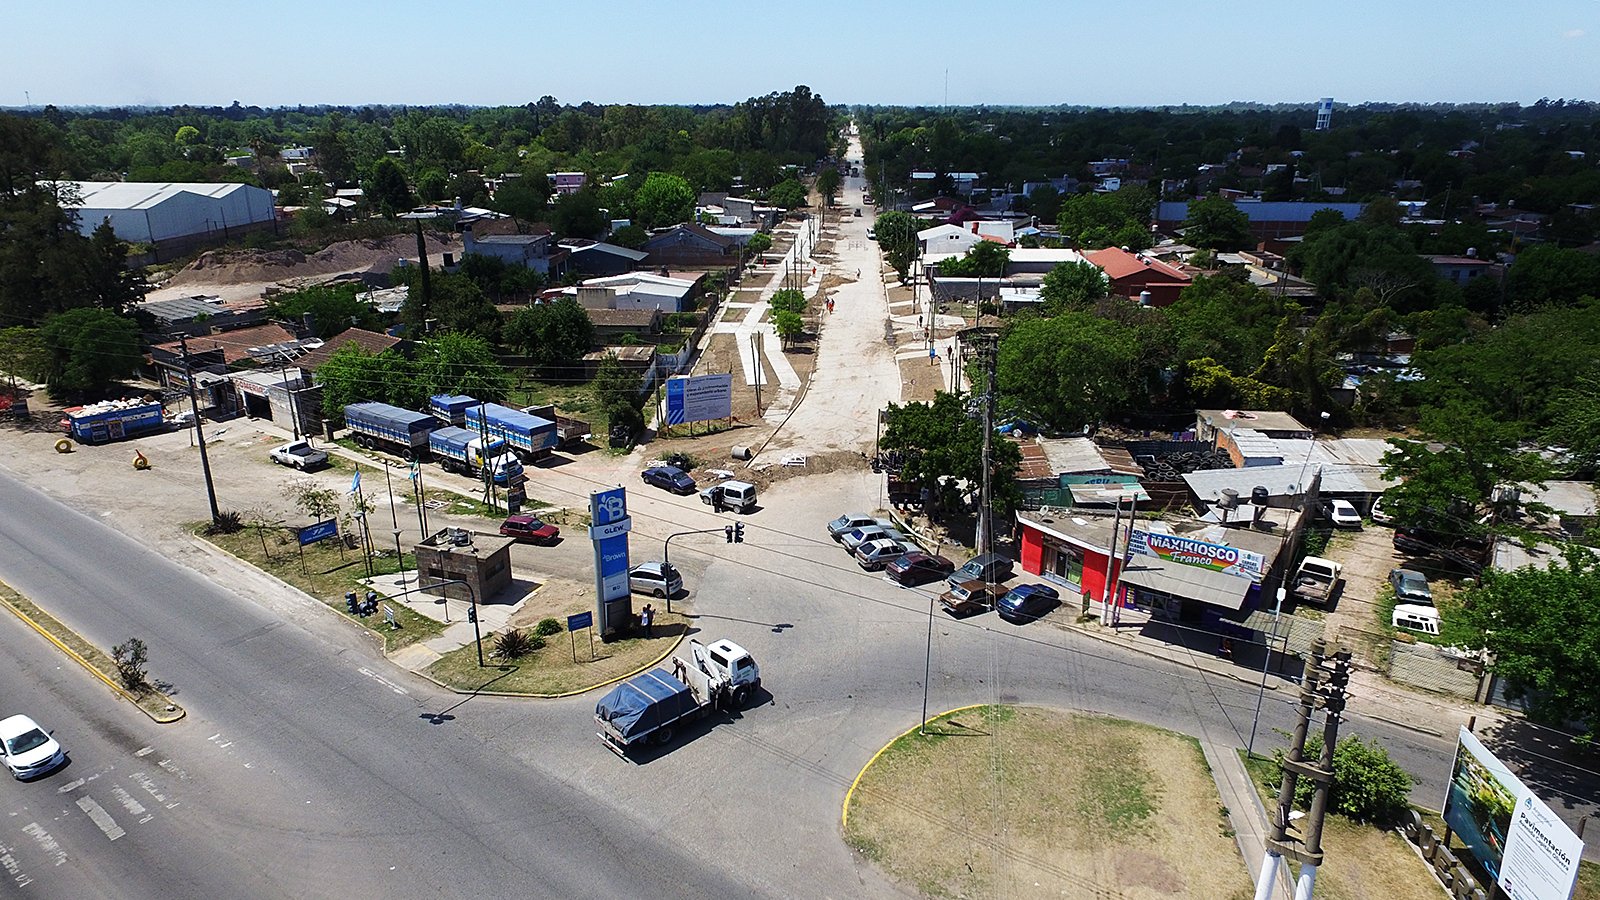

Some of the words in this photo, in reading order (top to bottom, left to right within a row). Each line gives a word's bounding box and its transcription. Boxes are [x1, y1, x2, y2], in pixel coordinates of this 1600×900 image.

[604, 524, 624, 534] GLEW
[1151, 534, 1236, 562] MAXIKIOSCO
[1169, 551, 1213, 565] Franco
[1520, 812, 1571, 866] Pavimentación
